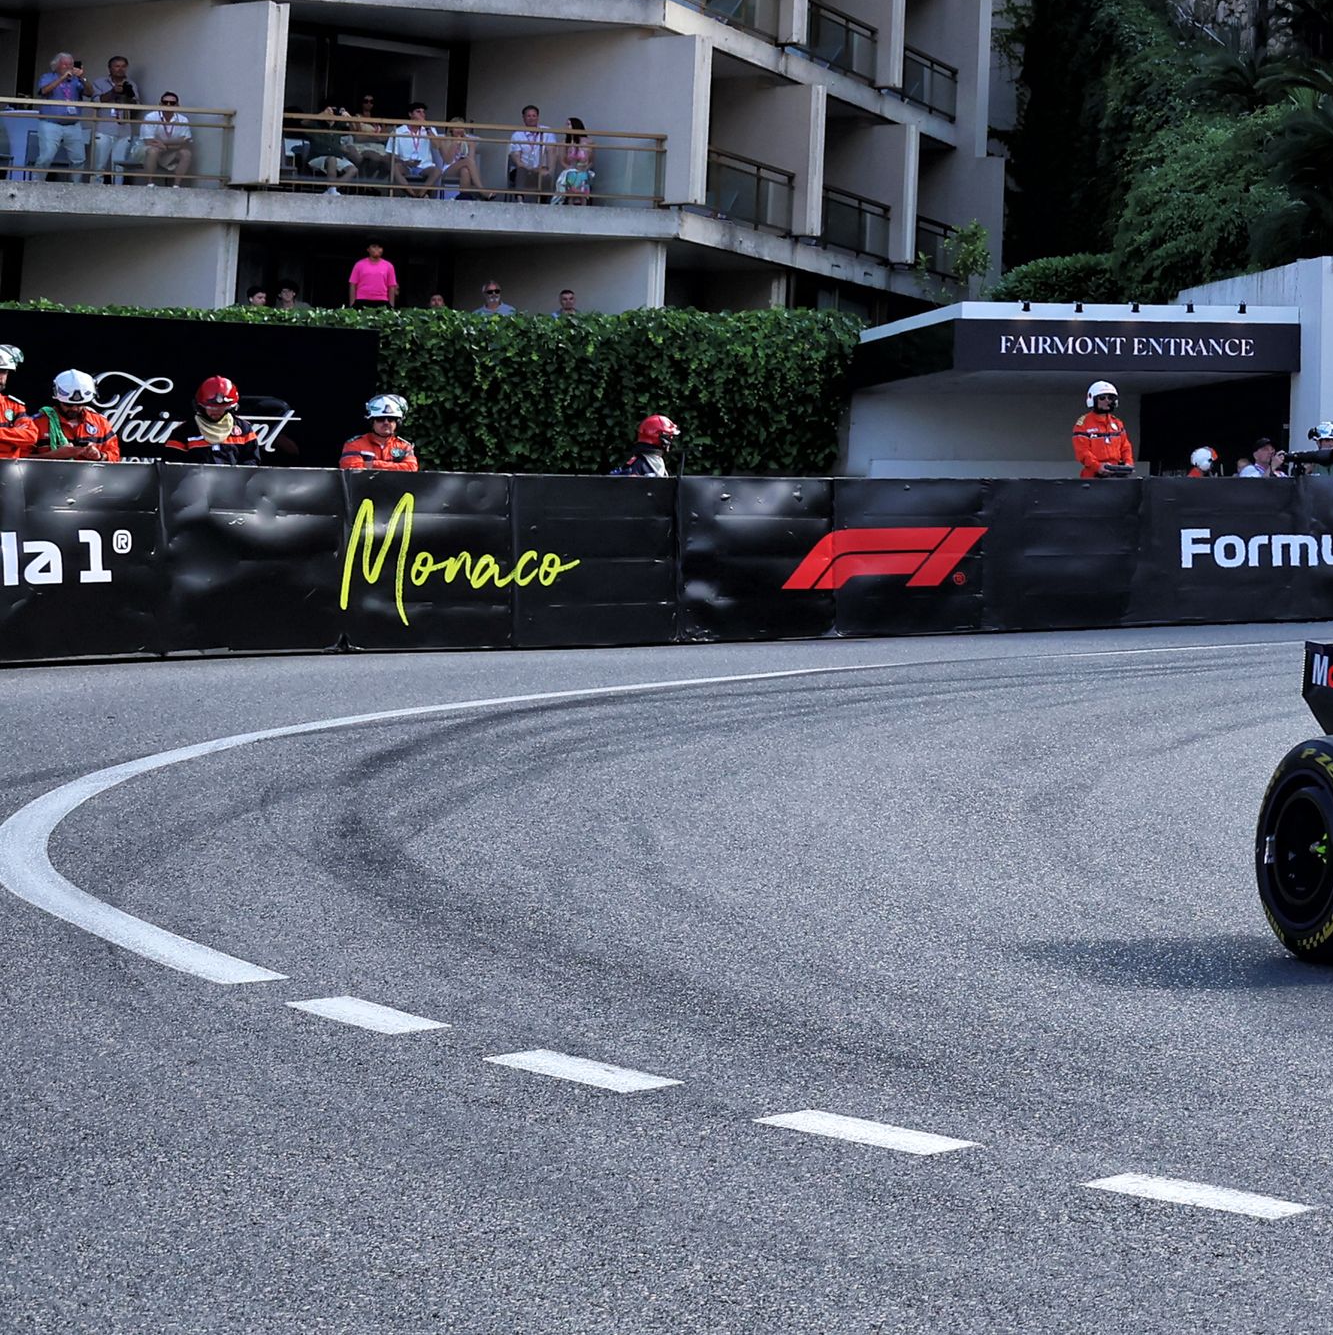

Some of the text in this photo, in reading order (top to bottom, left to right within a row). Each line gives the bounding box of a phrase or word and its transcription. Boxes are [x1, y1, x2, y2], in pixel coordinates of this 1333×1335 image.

[1000, 334, 1255, 357] FAIRMONT ENTRANCE
[340, 492, 581, 626] Monaco
[1300, 748, 1318, 760] P
